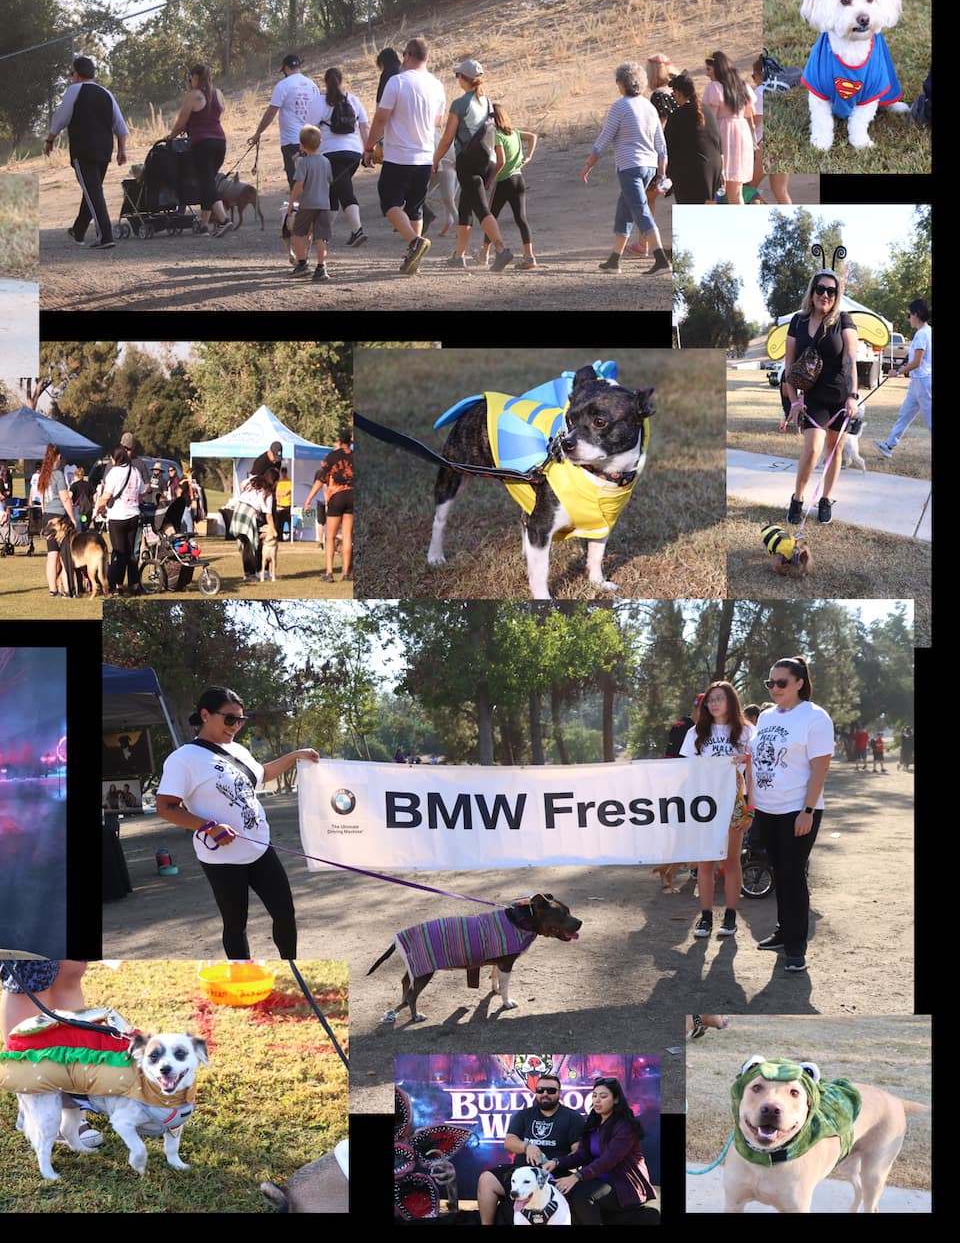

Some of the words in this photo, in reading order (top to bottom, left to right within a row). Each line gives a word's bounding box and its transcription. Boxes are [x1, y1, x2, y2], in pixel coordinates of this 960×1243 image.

[385, 791, 527, 830] BMW
[543, 792, 718, 829] Fresno
[450, 1092, 537, 1120] BULLY
